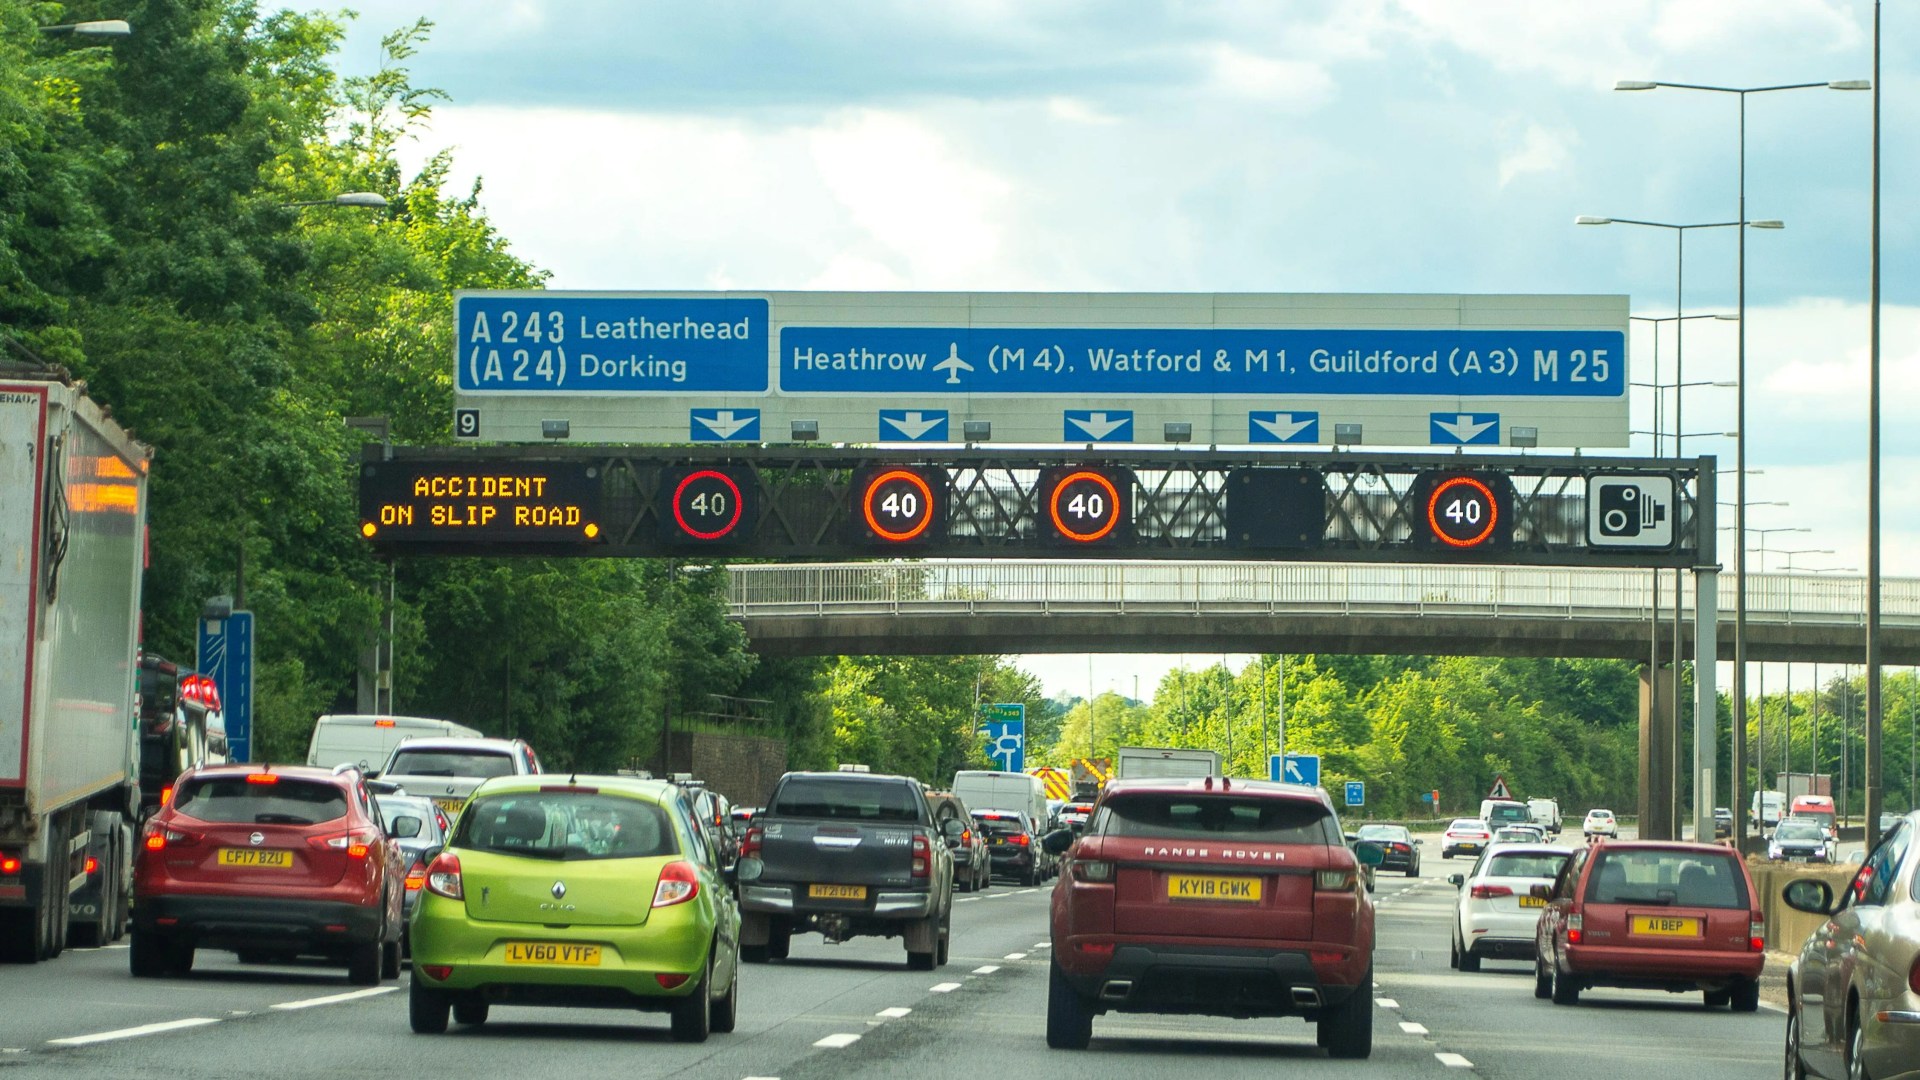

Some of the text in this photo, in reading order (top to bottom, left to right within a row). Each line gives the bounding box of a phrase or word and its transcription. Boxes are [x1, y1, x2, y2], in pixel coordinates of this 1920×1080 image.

[580, 316, 749, 340] Leatherhead
[580, 353, 687, 382] Dorking
[793, 347, 927, 370] Heathrow
[1088, 348, 1201, 372] Watford
[1212, 349, 1232, 372] &
[1309, 349, 1438, 373] Guildford
[460, 413, 476, 433] 9
[414, 477, 547, 497] ACCIDENT
[691, 492, 725, 516] 40
[881, 493, 917, 518] 40
[1068, 493, 1103, 519] 40
[1445, 499, 1481, 524] 40
[380, 505, 580, 526] ON SLIP ROAD
[226, 850, 284, 865] CF17 BZU
[1144, 847, 1285, 861] RANGE ROVER
[1179, 879, 1251, 896] KY18 GWK
[540, 903, 576, 911] CLIO
[1661, 919, 1684, 932] BEP
[512, 944, 595, 961] LV60 VTF
